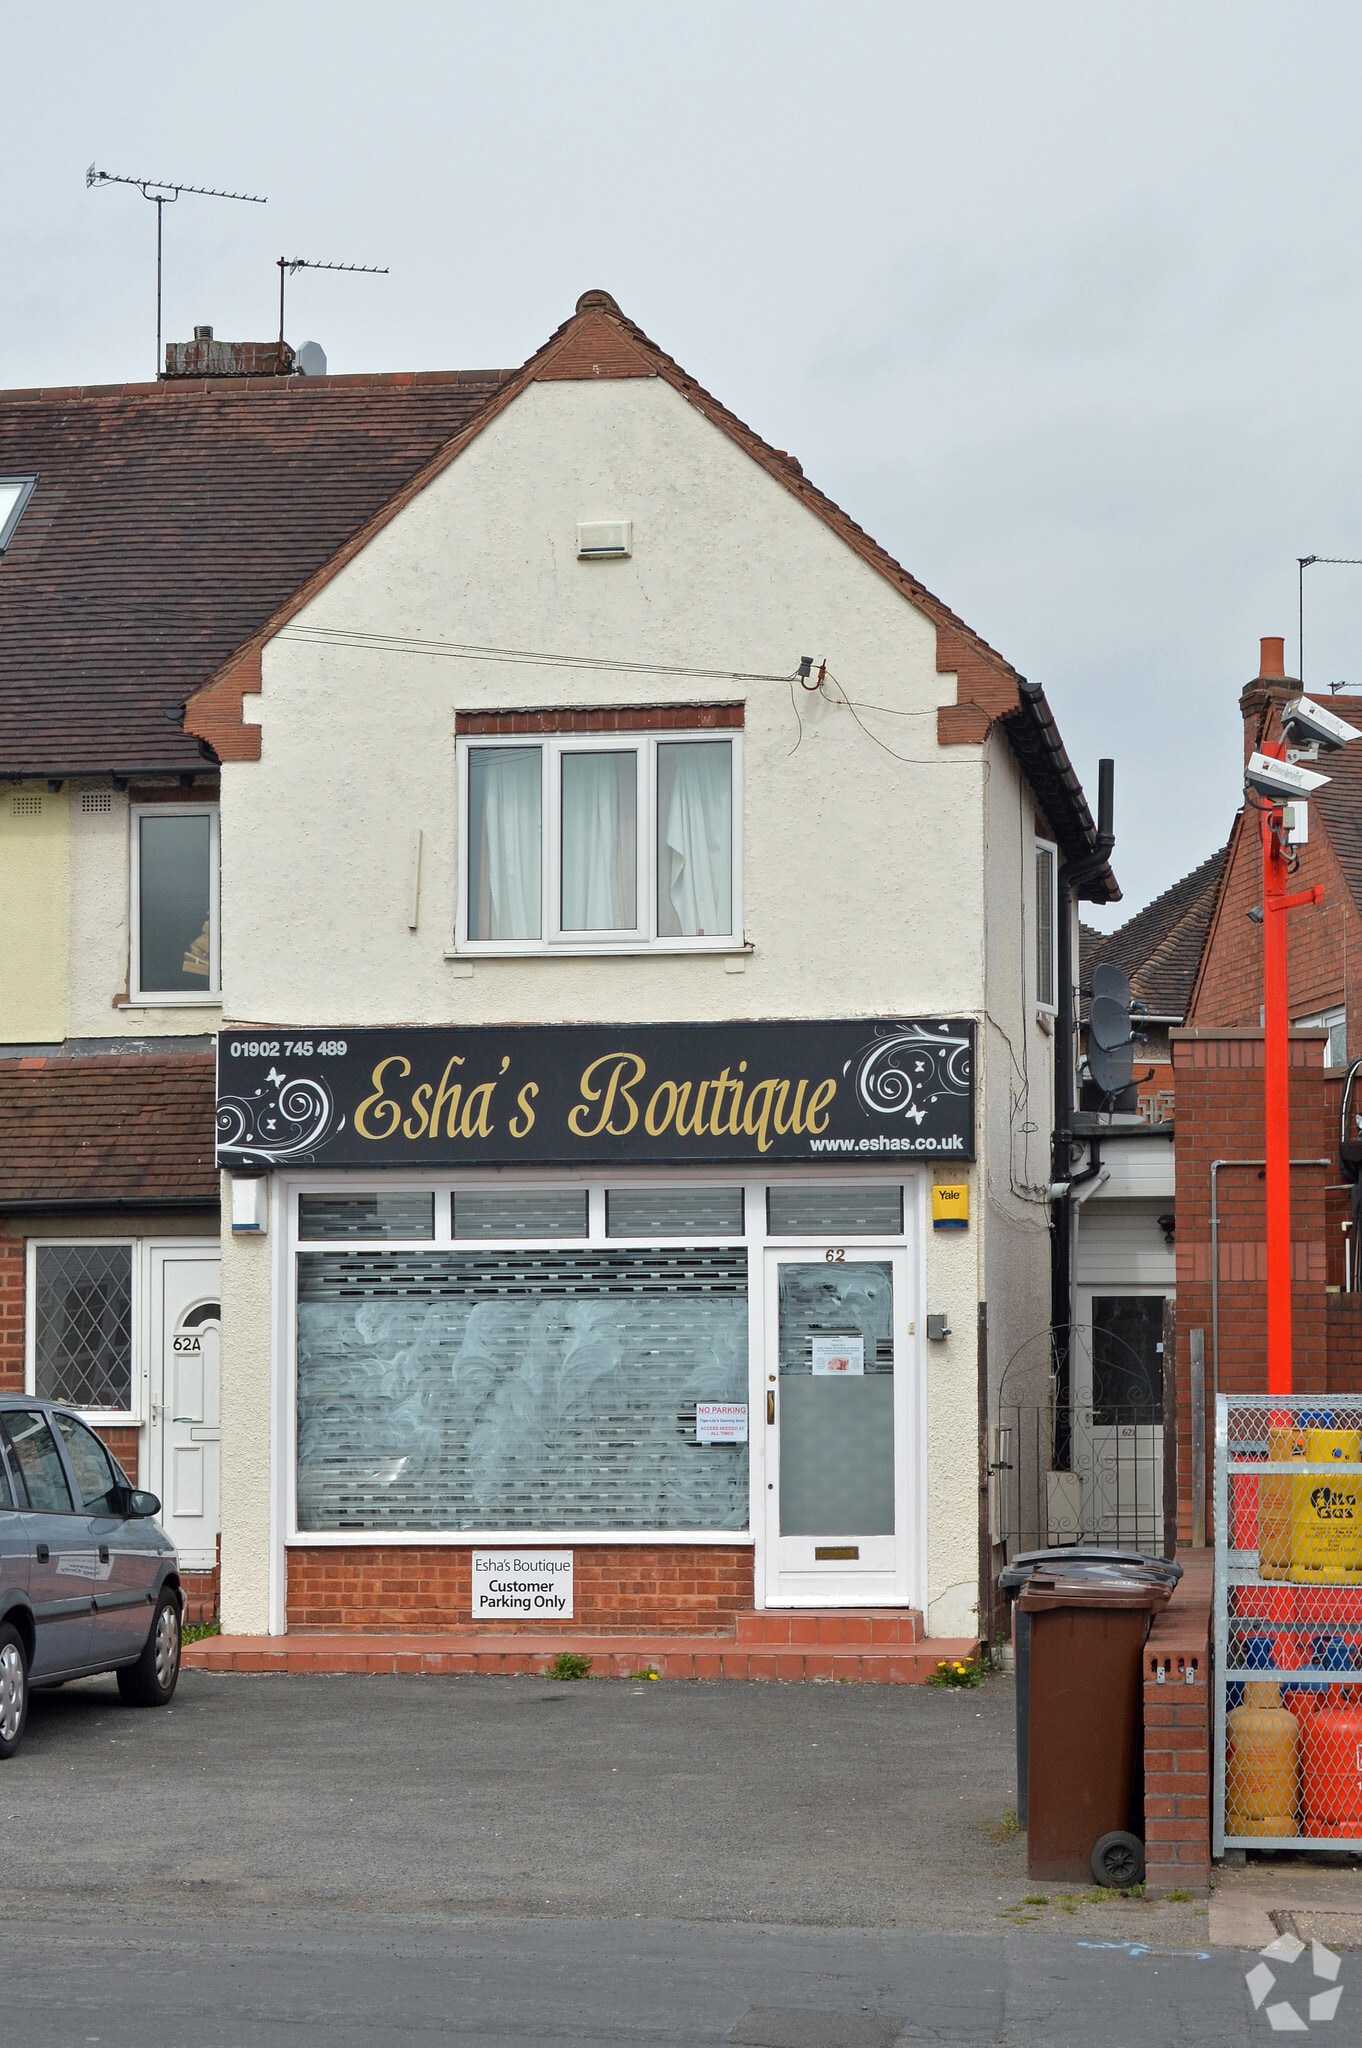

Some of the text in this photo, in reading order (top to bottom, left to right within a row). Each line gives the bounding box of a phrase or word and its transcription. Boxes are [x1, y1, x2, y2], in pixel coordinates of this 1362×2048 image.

[230, 1040, 348, 1057] 01902 745 489
[354, 1052, 837, 1152] Esha's Boutique
[809, 1134, 964, 1151] www.eshas.co.uk
[939, 1190, 960, 1200] Yale
[825, 1249, 845, 1262] 62
[173, 1337, 201, 1351] 62A
[699, 1406, 746, 1414] NO PARKING
[1317, 1506, 1353, 1518] Gas
[475, 1559, 571, 1575] Esha's Boutique
[489, 1580, 555, 1592] Customer
[480, 1595, 566, 1611] Parking Only
